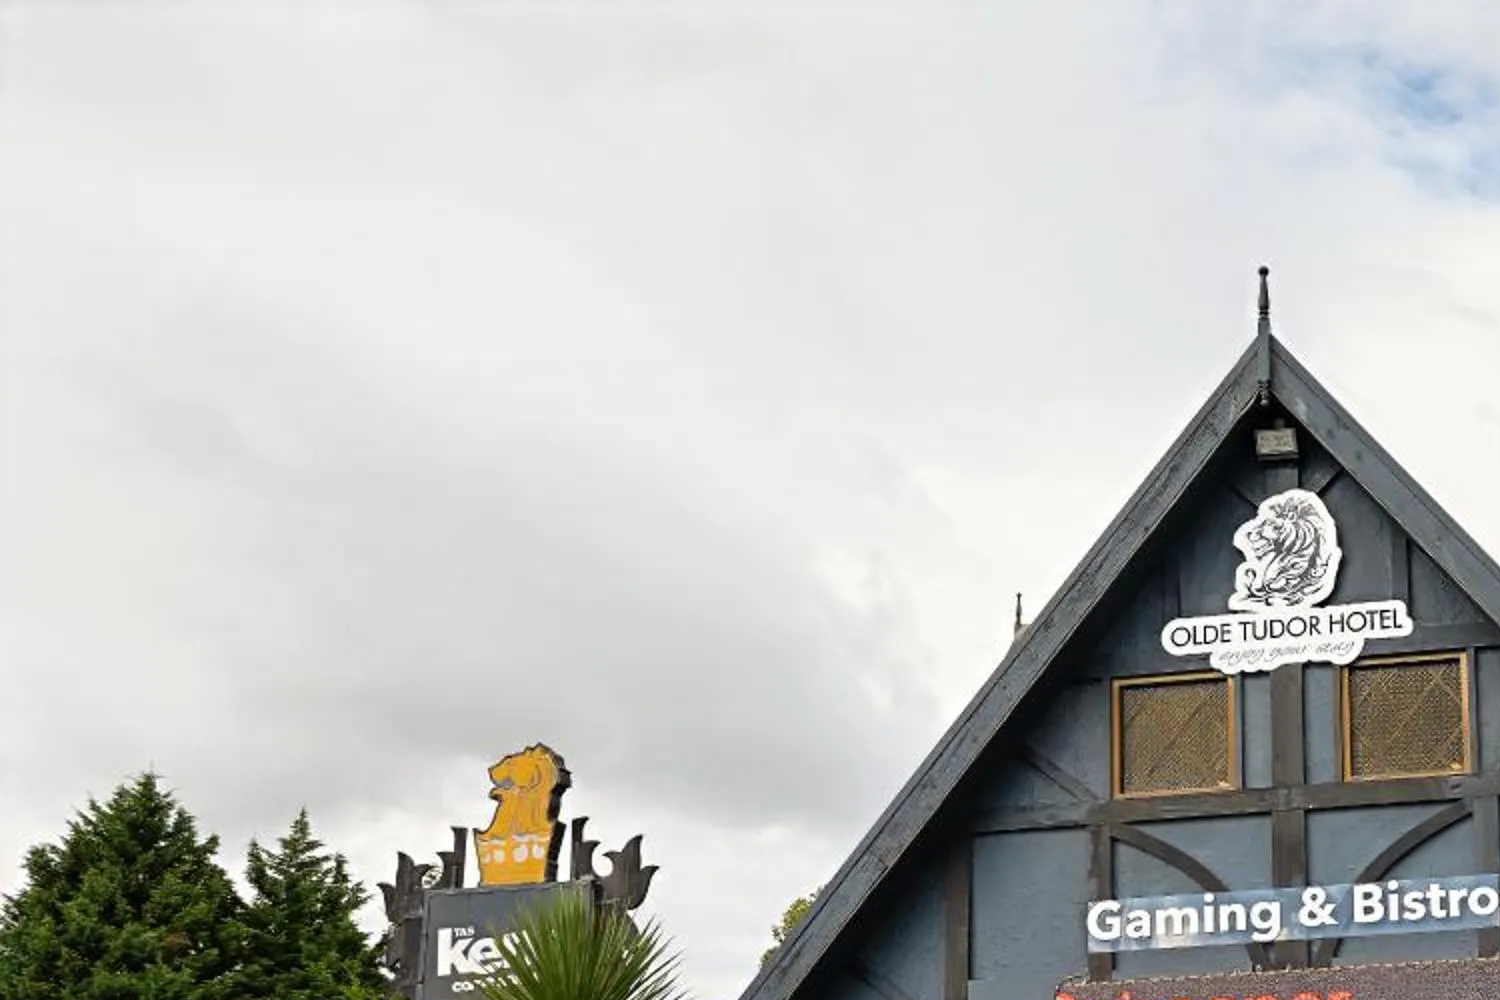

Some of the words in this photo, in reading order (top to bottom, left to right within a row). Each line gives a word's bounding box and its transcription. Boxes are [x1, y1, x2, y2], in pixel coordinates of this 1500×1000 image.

[1170, 622, 1231, 647] OLDE
[1239, 616, 1321, 640] TUDOR
[1329, 608, 1402, 633] HOTEL
[1086, 894, 1282, 942] Gaming
[1299, 886, 1336, 927] &
[1352, 880, 1500, 923] Bistro
